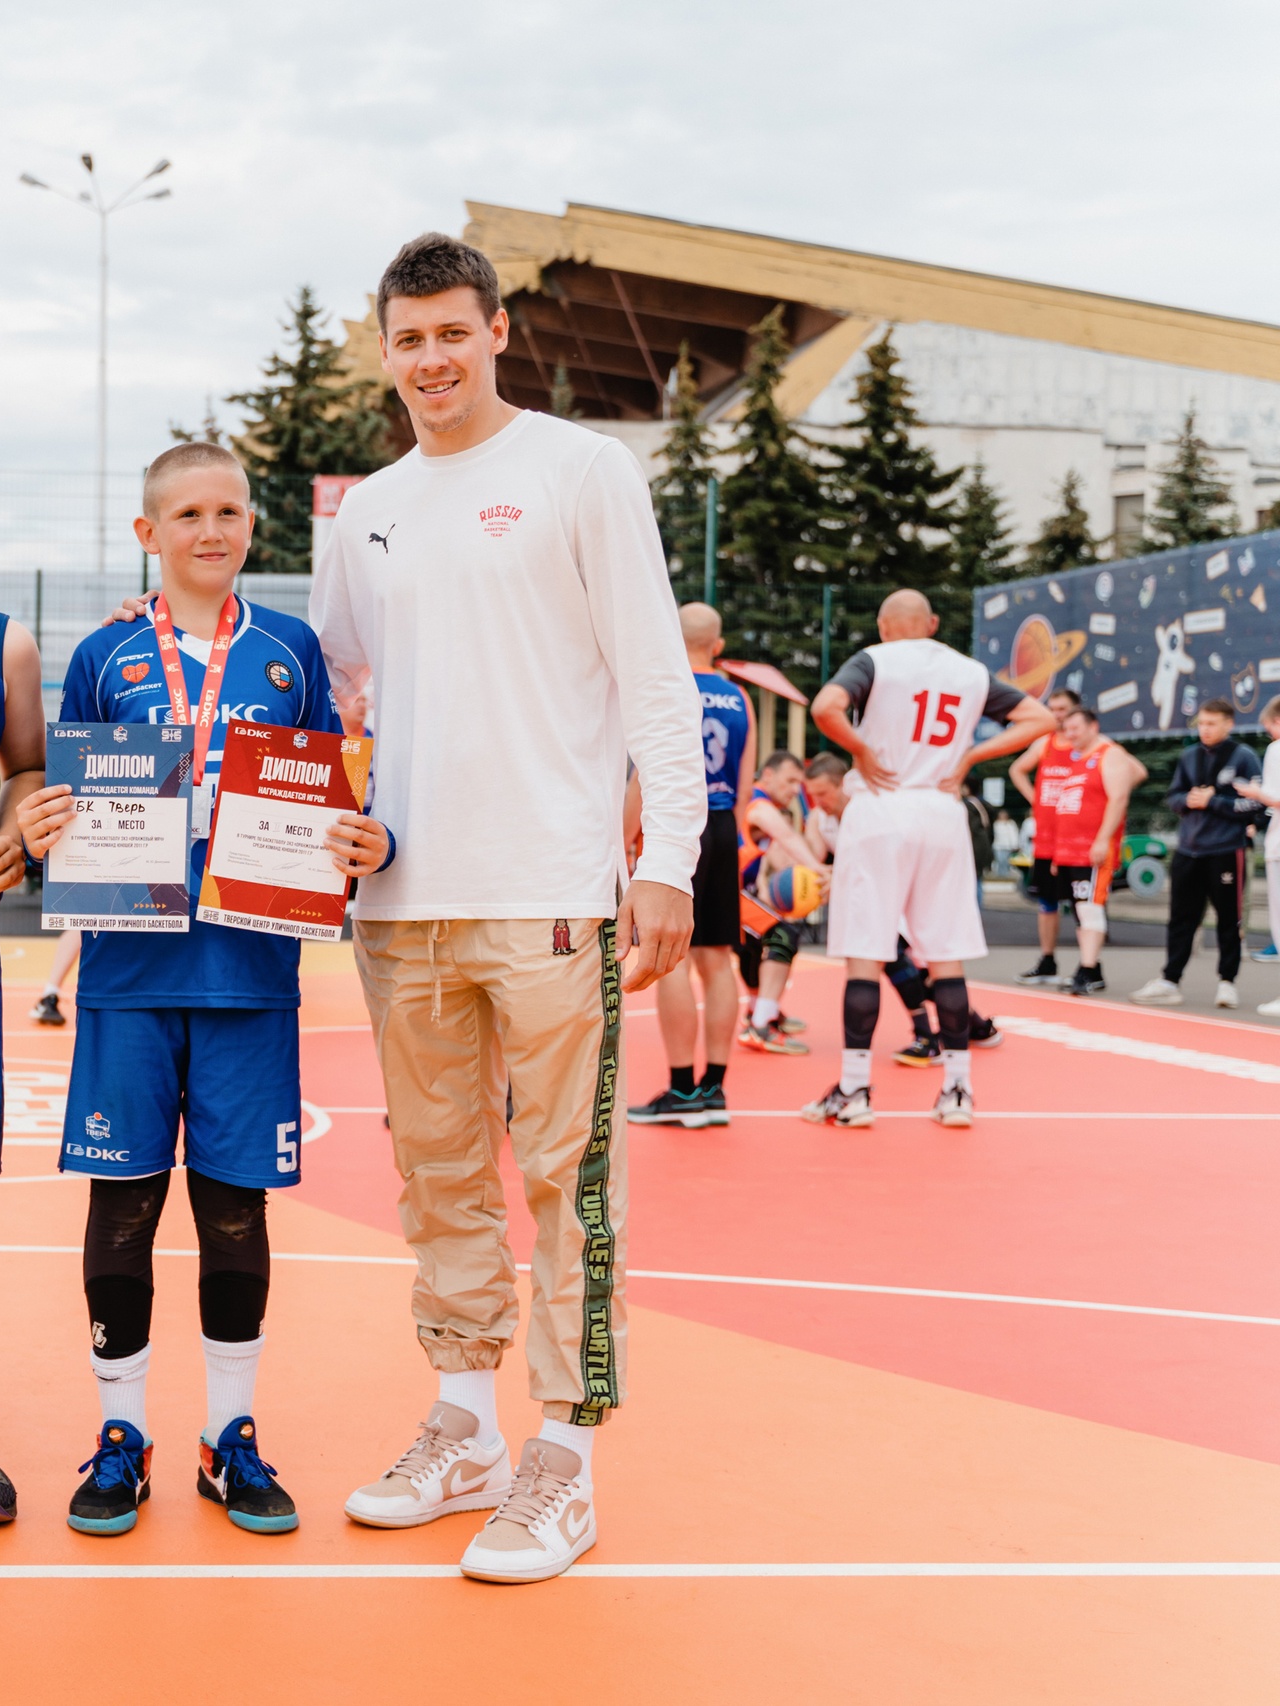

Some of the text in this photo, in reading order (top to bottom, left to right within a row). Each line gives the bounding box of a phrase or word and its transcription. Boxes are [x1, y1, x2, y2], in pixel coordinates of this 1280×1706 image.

[479, 505, 523, 522] RUSSIA
[173, 688, 186, 714] DKC
[200, 702, 213, 728] DKC
[911, 689, 962, 747] 15
[67, 730, 91, 738] DKC
[247, 729, 272, 739] DKC
[85, 754, 155, 779] ДИПЛОМ
[259, 756, 331, 787] ДИПЛОМ
[80, 785, 159, 795] НАГРАЖДАЕТСЯ КОМАНДА
[258, 786, 325, 804] НАГРАЖДАЕТСЯ ИГРОК
[76, 800, 94, 813] БК
[91, 819, 102, 829] ЗА
[118, 820, 145, 830] МЕСТО
[258, 820, 270, 831] ЗА
[285, 824, 313, 837] МЕСТО
[70, 917, 183, 929] ТВЕРСКОЙ ЦЕНТР УЛИЧНОГО БАСКЕТБОЛА
[223, 914, 336, 938] ТВЕРСКОЙ ЦЕНТР УЛИЧНОГО БАСКЕТБОЛА
[589, 1053, 616, 1156] TURTLES
[85, 1128, 111, 1138] ТВЕРЬ
[85, 1146, 130, 1162] DKC
[276, 1121, 297, 1173] 5
[581, 1179, 610, 1282] TURTLES
[586, 1306, 612, 1409] TURTLES
